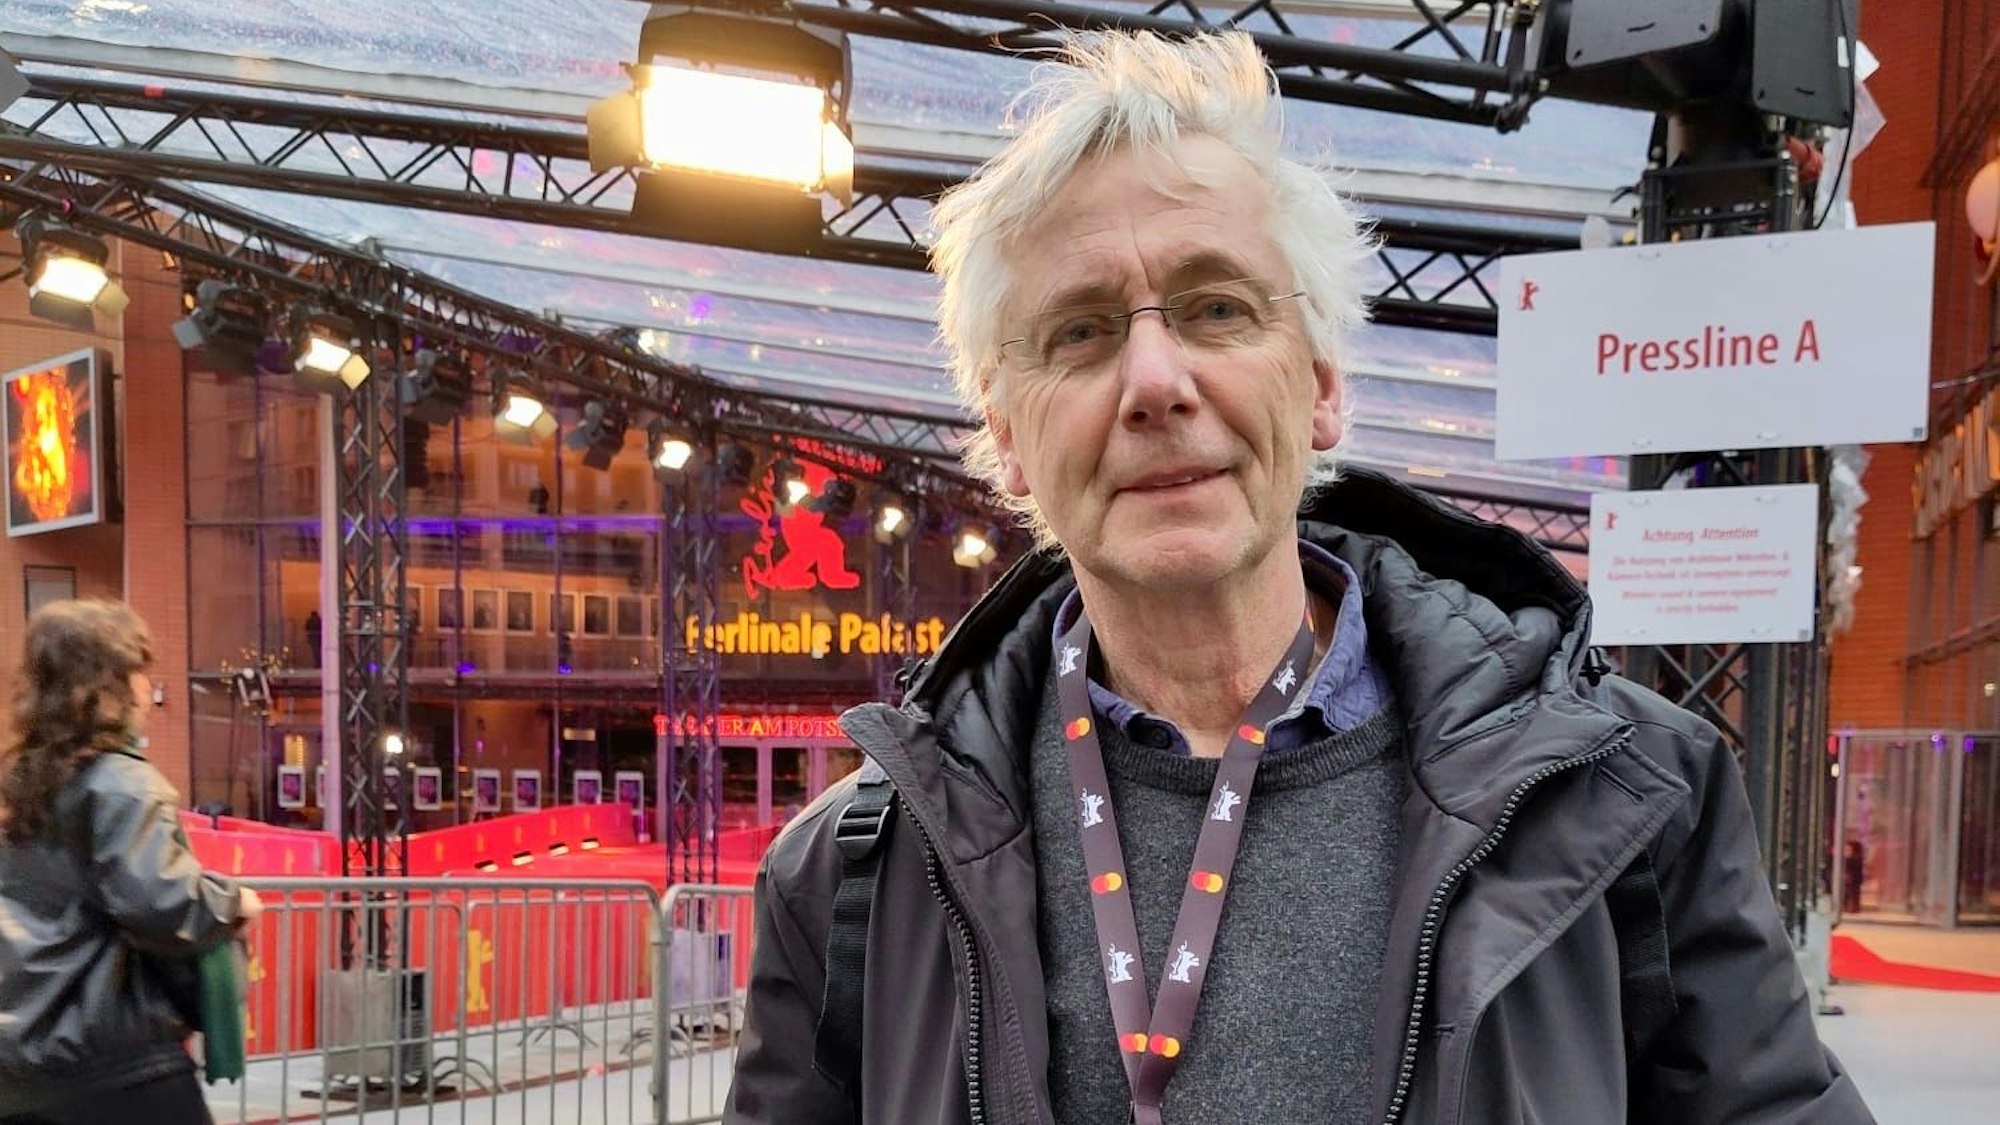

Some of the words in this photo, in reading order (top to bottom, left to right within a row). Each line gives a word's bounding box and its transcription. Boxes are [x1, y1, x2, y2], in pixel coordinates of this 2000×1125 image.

[1598, 325, 1779, 375] Pressline
[1794, 319, 1820, 363] A
[840, 611, 945, 655] Palast
[784, 715, 847, 738] POTS
